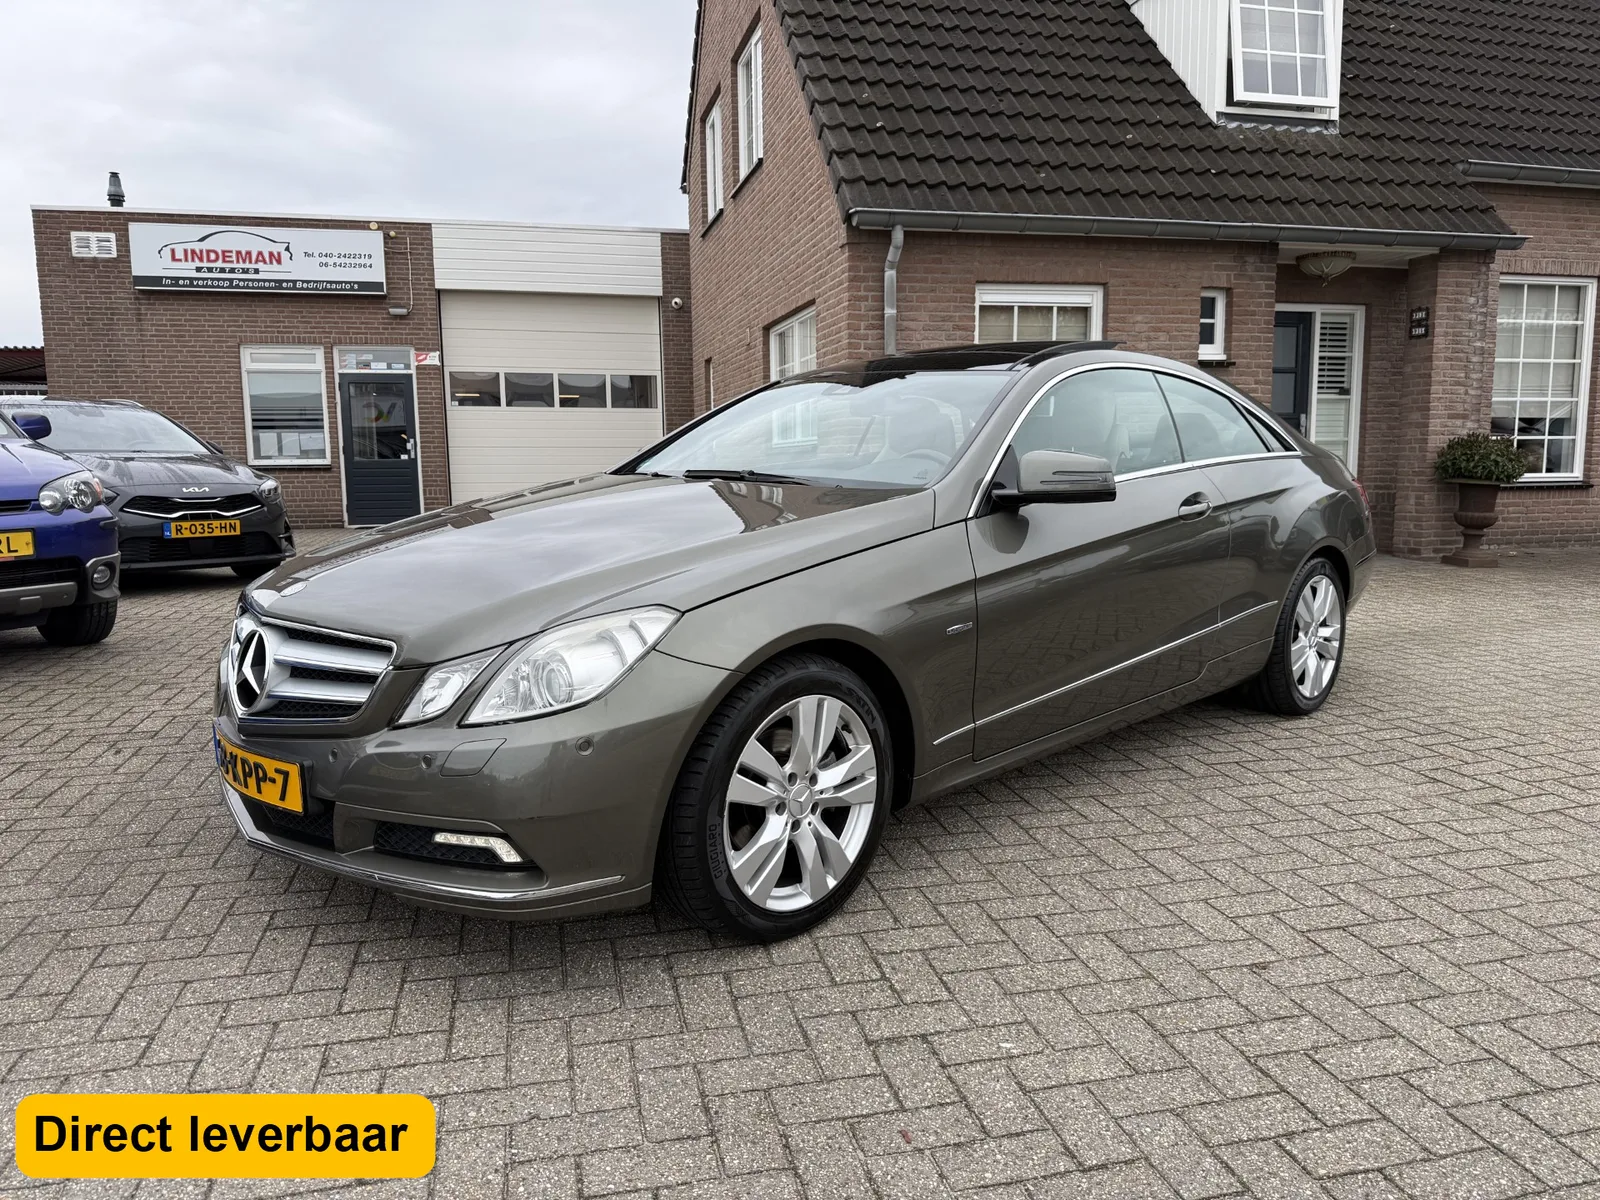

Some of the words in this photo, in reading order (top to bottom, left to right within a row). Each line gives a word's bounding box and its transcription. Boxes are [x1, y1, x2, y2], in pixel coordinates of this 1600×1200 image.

[170, 248, 282, 265] LINDEMAN
[193, 279, 229, 287] verkoop
[233, 279, 279, 287] Personen-
[296, 281, 358, 289] Bedrijfsauto's
[175, 522, 237, 536] R-035-HN
[708, 824, 723, 879] GIUGIARO
